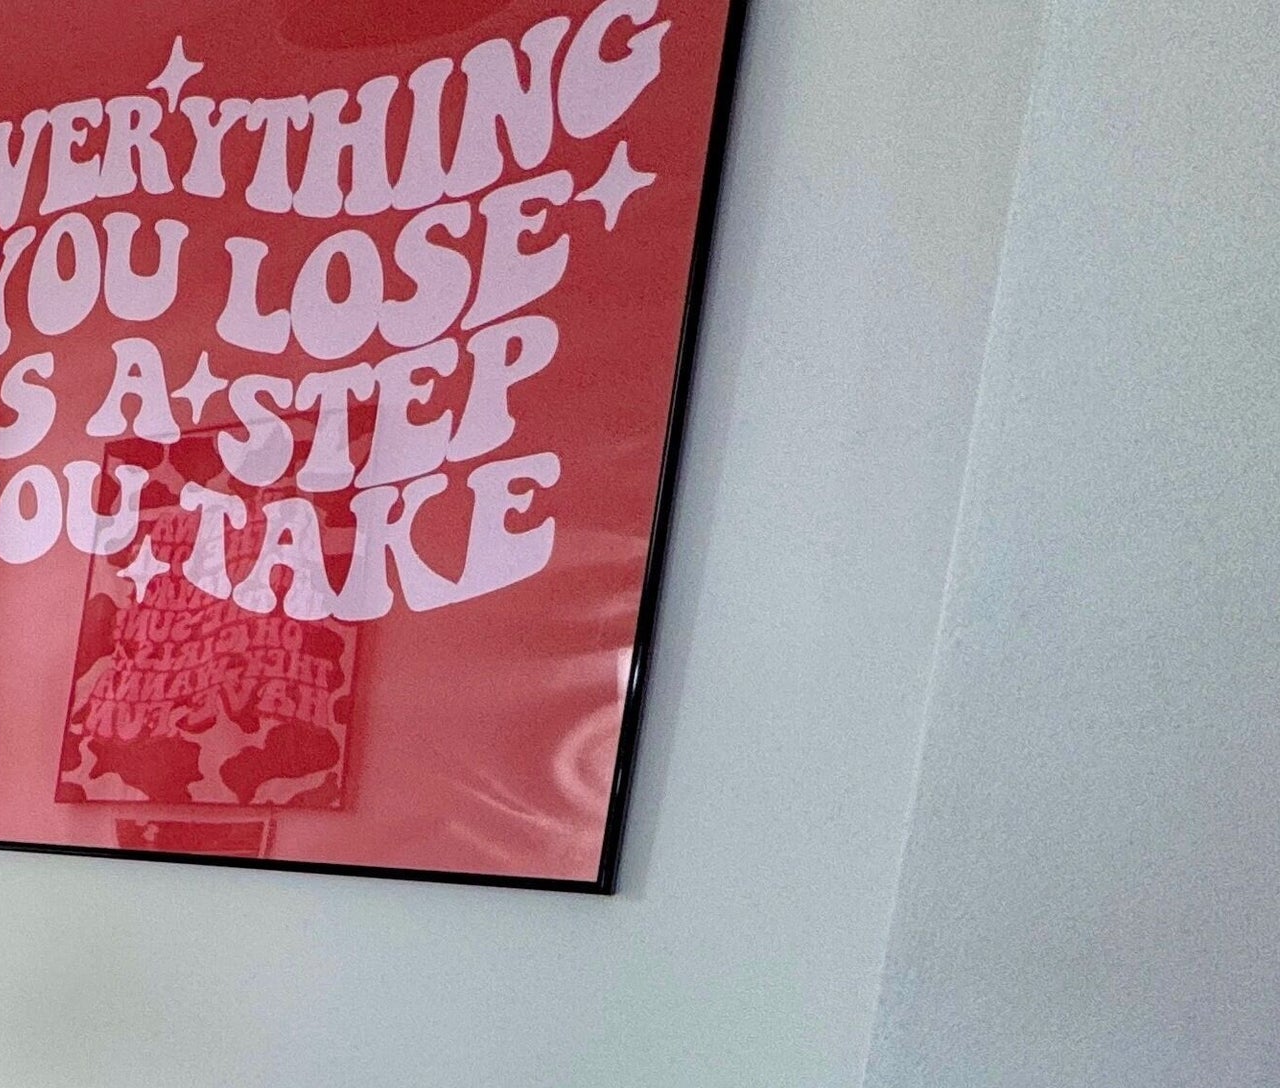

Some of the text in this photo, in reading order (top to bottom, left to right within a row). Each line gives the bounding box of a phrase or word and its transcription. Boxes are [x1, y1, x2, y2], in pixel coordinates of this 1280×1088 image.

[216, 171, 571, 359] LOSE
[86, 337, 183, 440] A
[218, 315, 559, 492] STEP
[180, 452, 561, 620] TAKE
